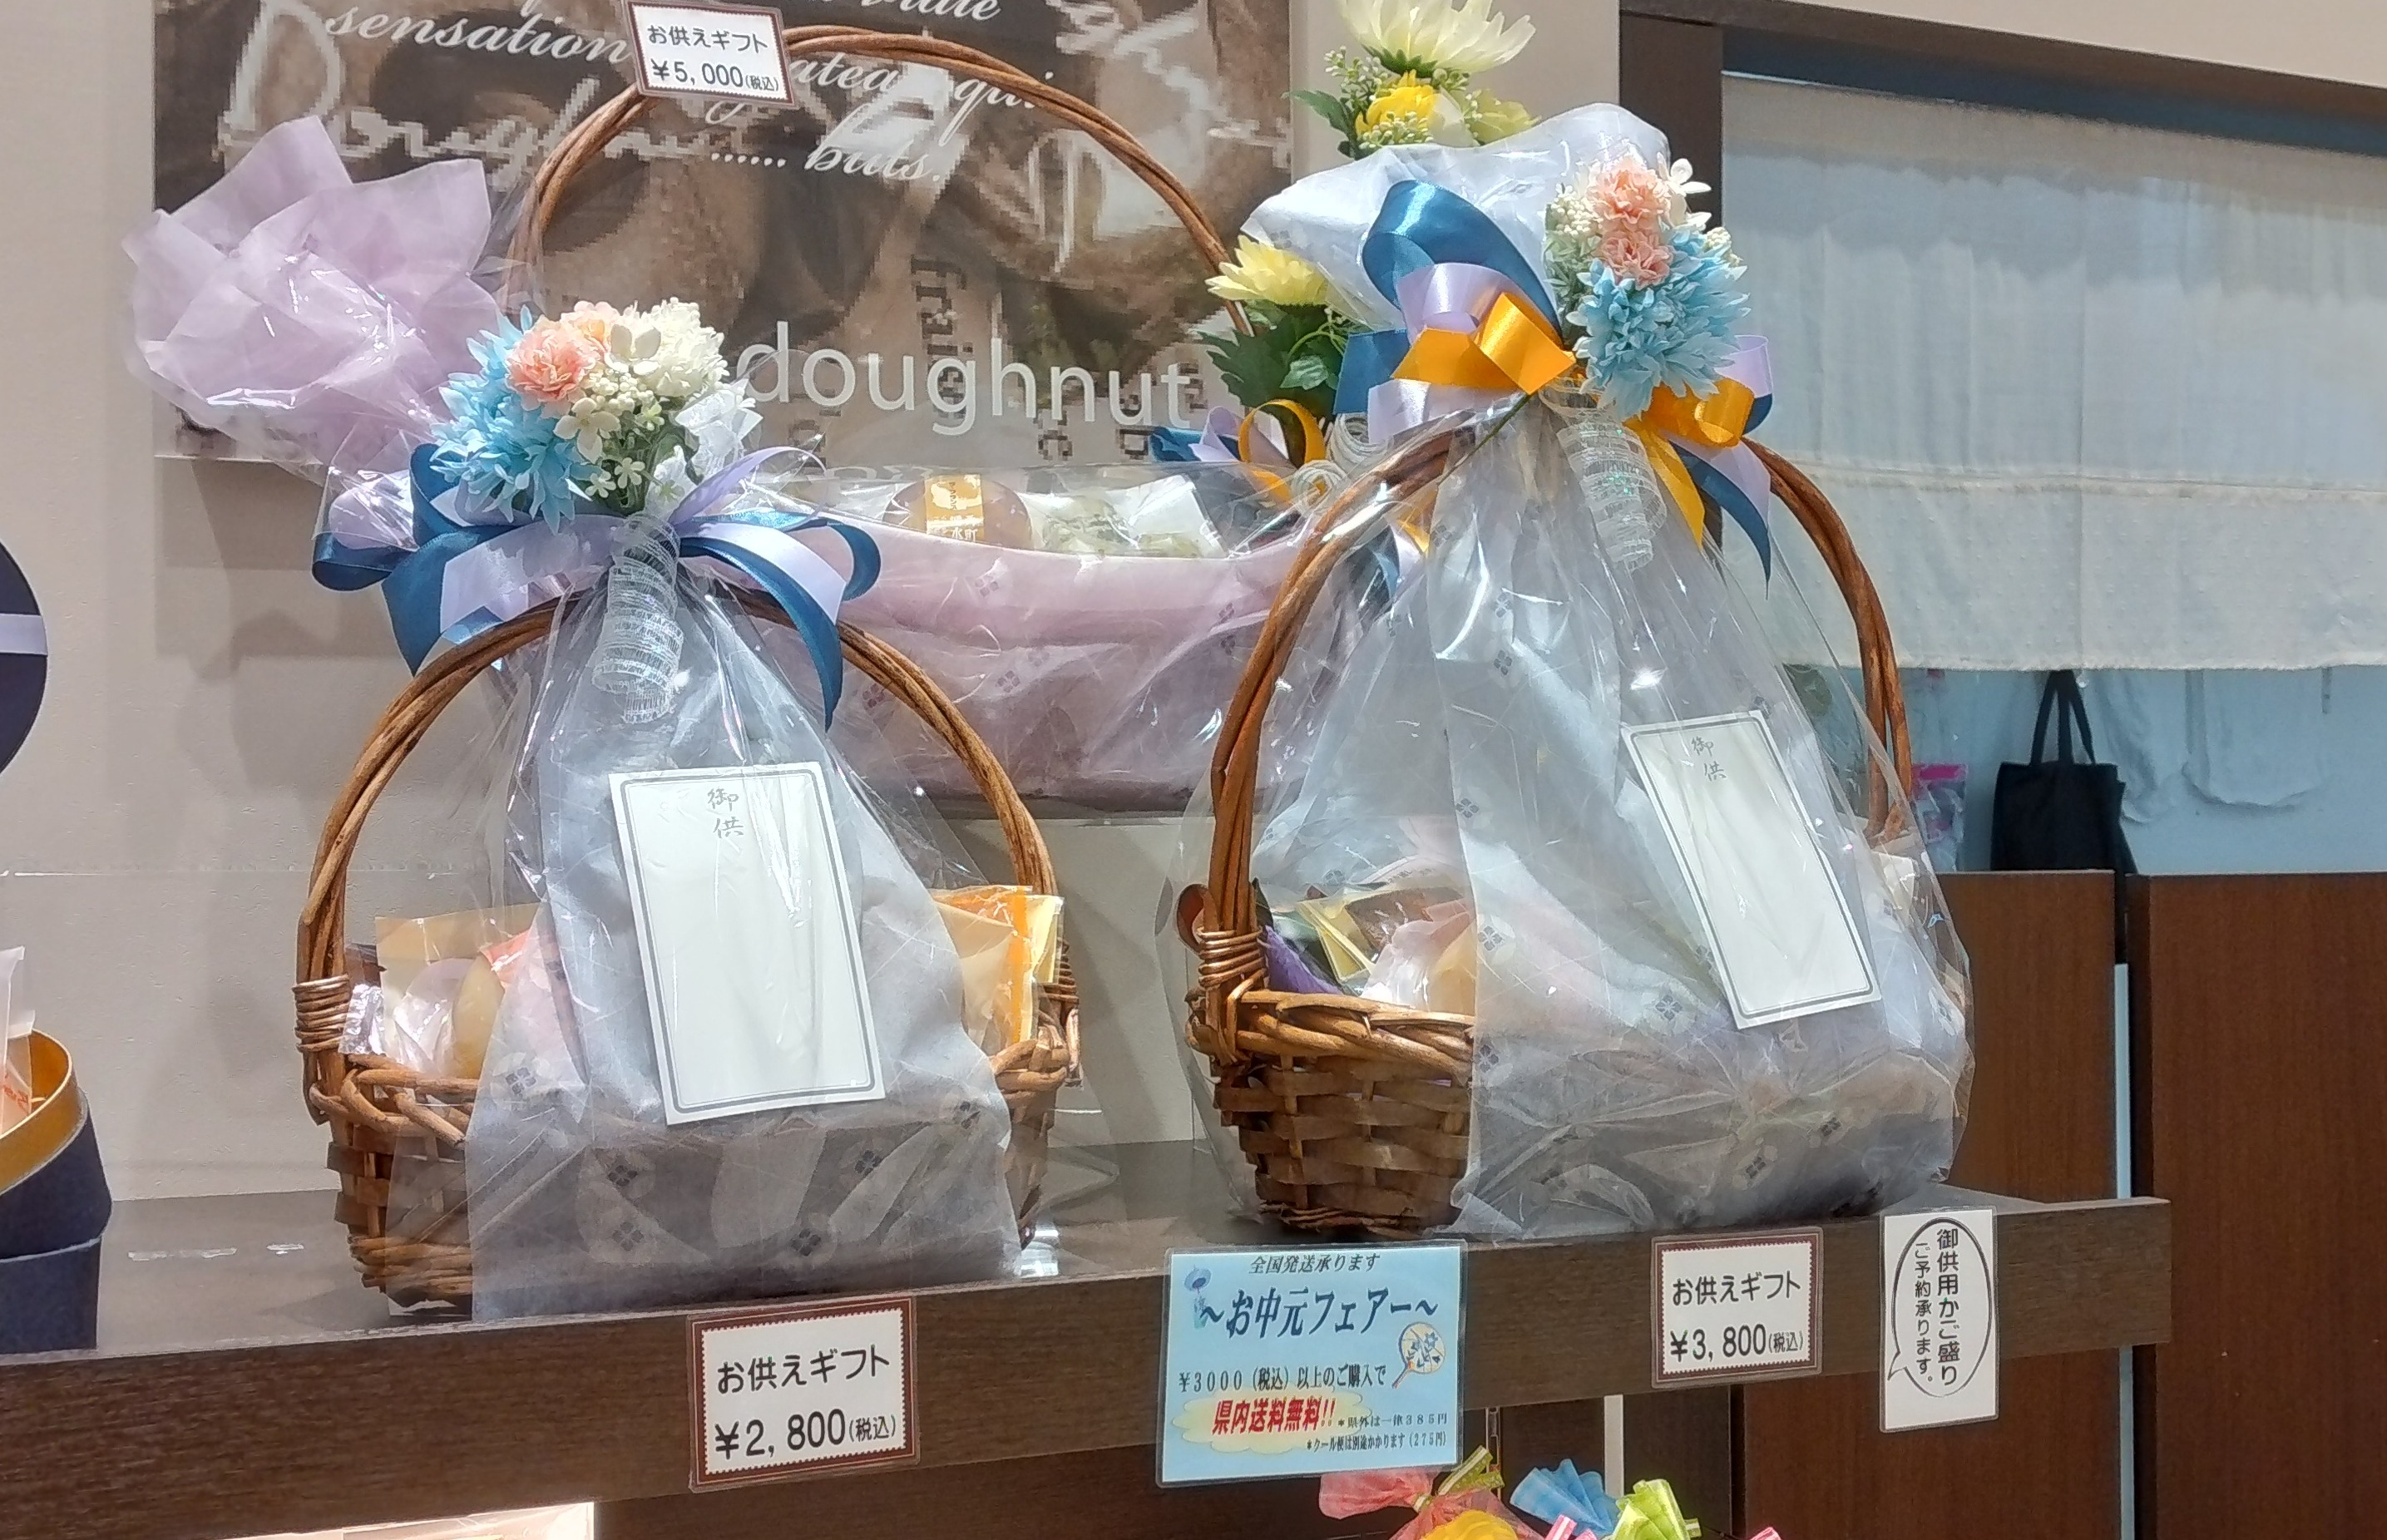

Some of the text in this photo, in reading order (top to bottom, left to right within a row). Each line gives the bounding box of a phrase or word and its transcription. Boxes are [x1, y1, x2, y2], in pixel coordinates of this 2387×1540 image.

[325, 6, 633, 64] sensation
[647, 25, 768, 54] お供えギフト
[736, 320, 1198, 437] doughnut
[707, 787, 744, 839] 御供
[1248, 1252, 1381, 1275] 全国発送承ります
[1672, 1270, 1801, 1306] お供えギフト
[1915, 1241, 1934, 1383] ご予約承ります。
[1936, 1227, 1961, 1387] 御供用かご盛り
[717, 1343, 890, 1394] お供えギフト
